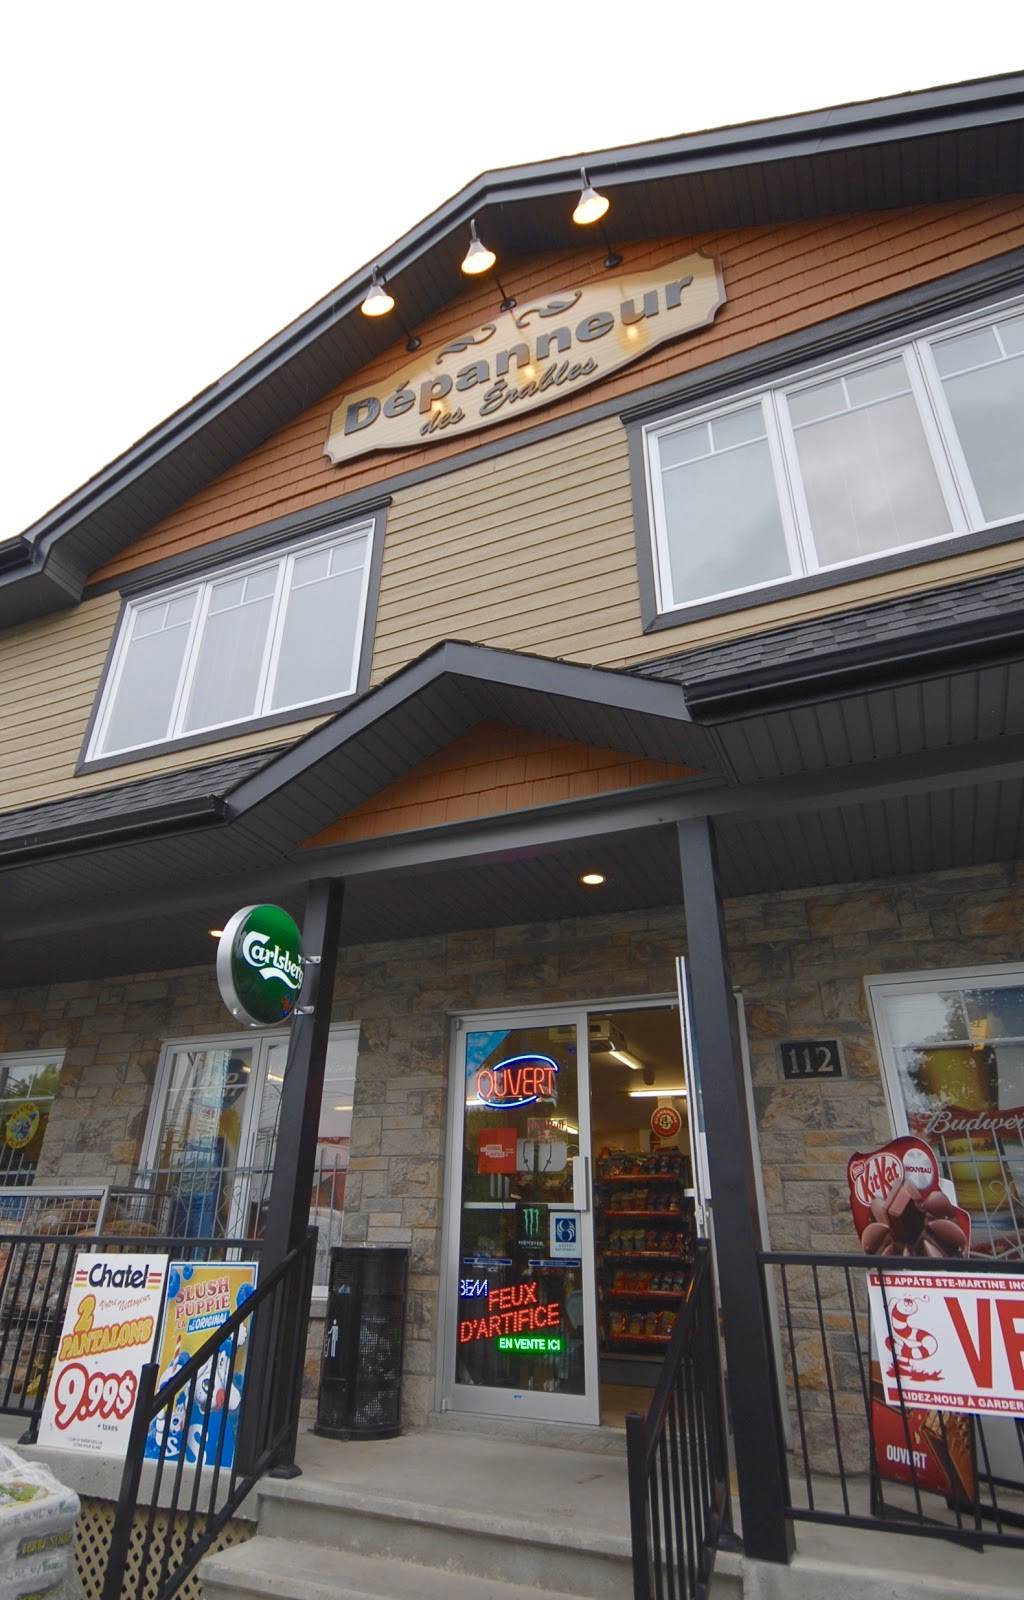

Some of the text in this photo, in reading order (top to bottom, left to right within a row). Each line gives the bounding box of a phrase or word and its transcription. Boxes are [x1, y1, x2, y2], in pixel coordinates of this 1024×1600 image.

[344, 272, 695, 436] Dépanneur
[419, 358, 599, 436] des Érables
[243, 930, 304, 990] Carlsberg
[788, 1046, 834, 1074] 112
[477, 1067, 557, 1098] OUVERT
[905, 1165, 932, 1174] NOUVEAU
[89, 1263, 149, 1289] Chatel
[175, 1277, 231, 1304] SLUSH
[873, 1276, 892, 1285] LS
[894, 1276, 933, 1287] APPÂTS
[935, 1279, 1006, 1289] STE-MARTINE
[488, 1282, 537, 1312] FEUX
[74, 1294, 97, 1333] 2
[460, 1303, 560, 1343] D'ARTIFICE
[59, 1316, 154, 1361] PANTALONS
[500, 1338, 560, 1351] EN VENTE ICI
[54, 1362, 138, 1431] 9.99$
[902, 1391, 1024, 1411] AIDEZ-NOUS À GARDER
